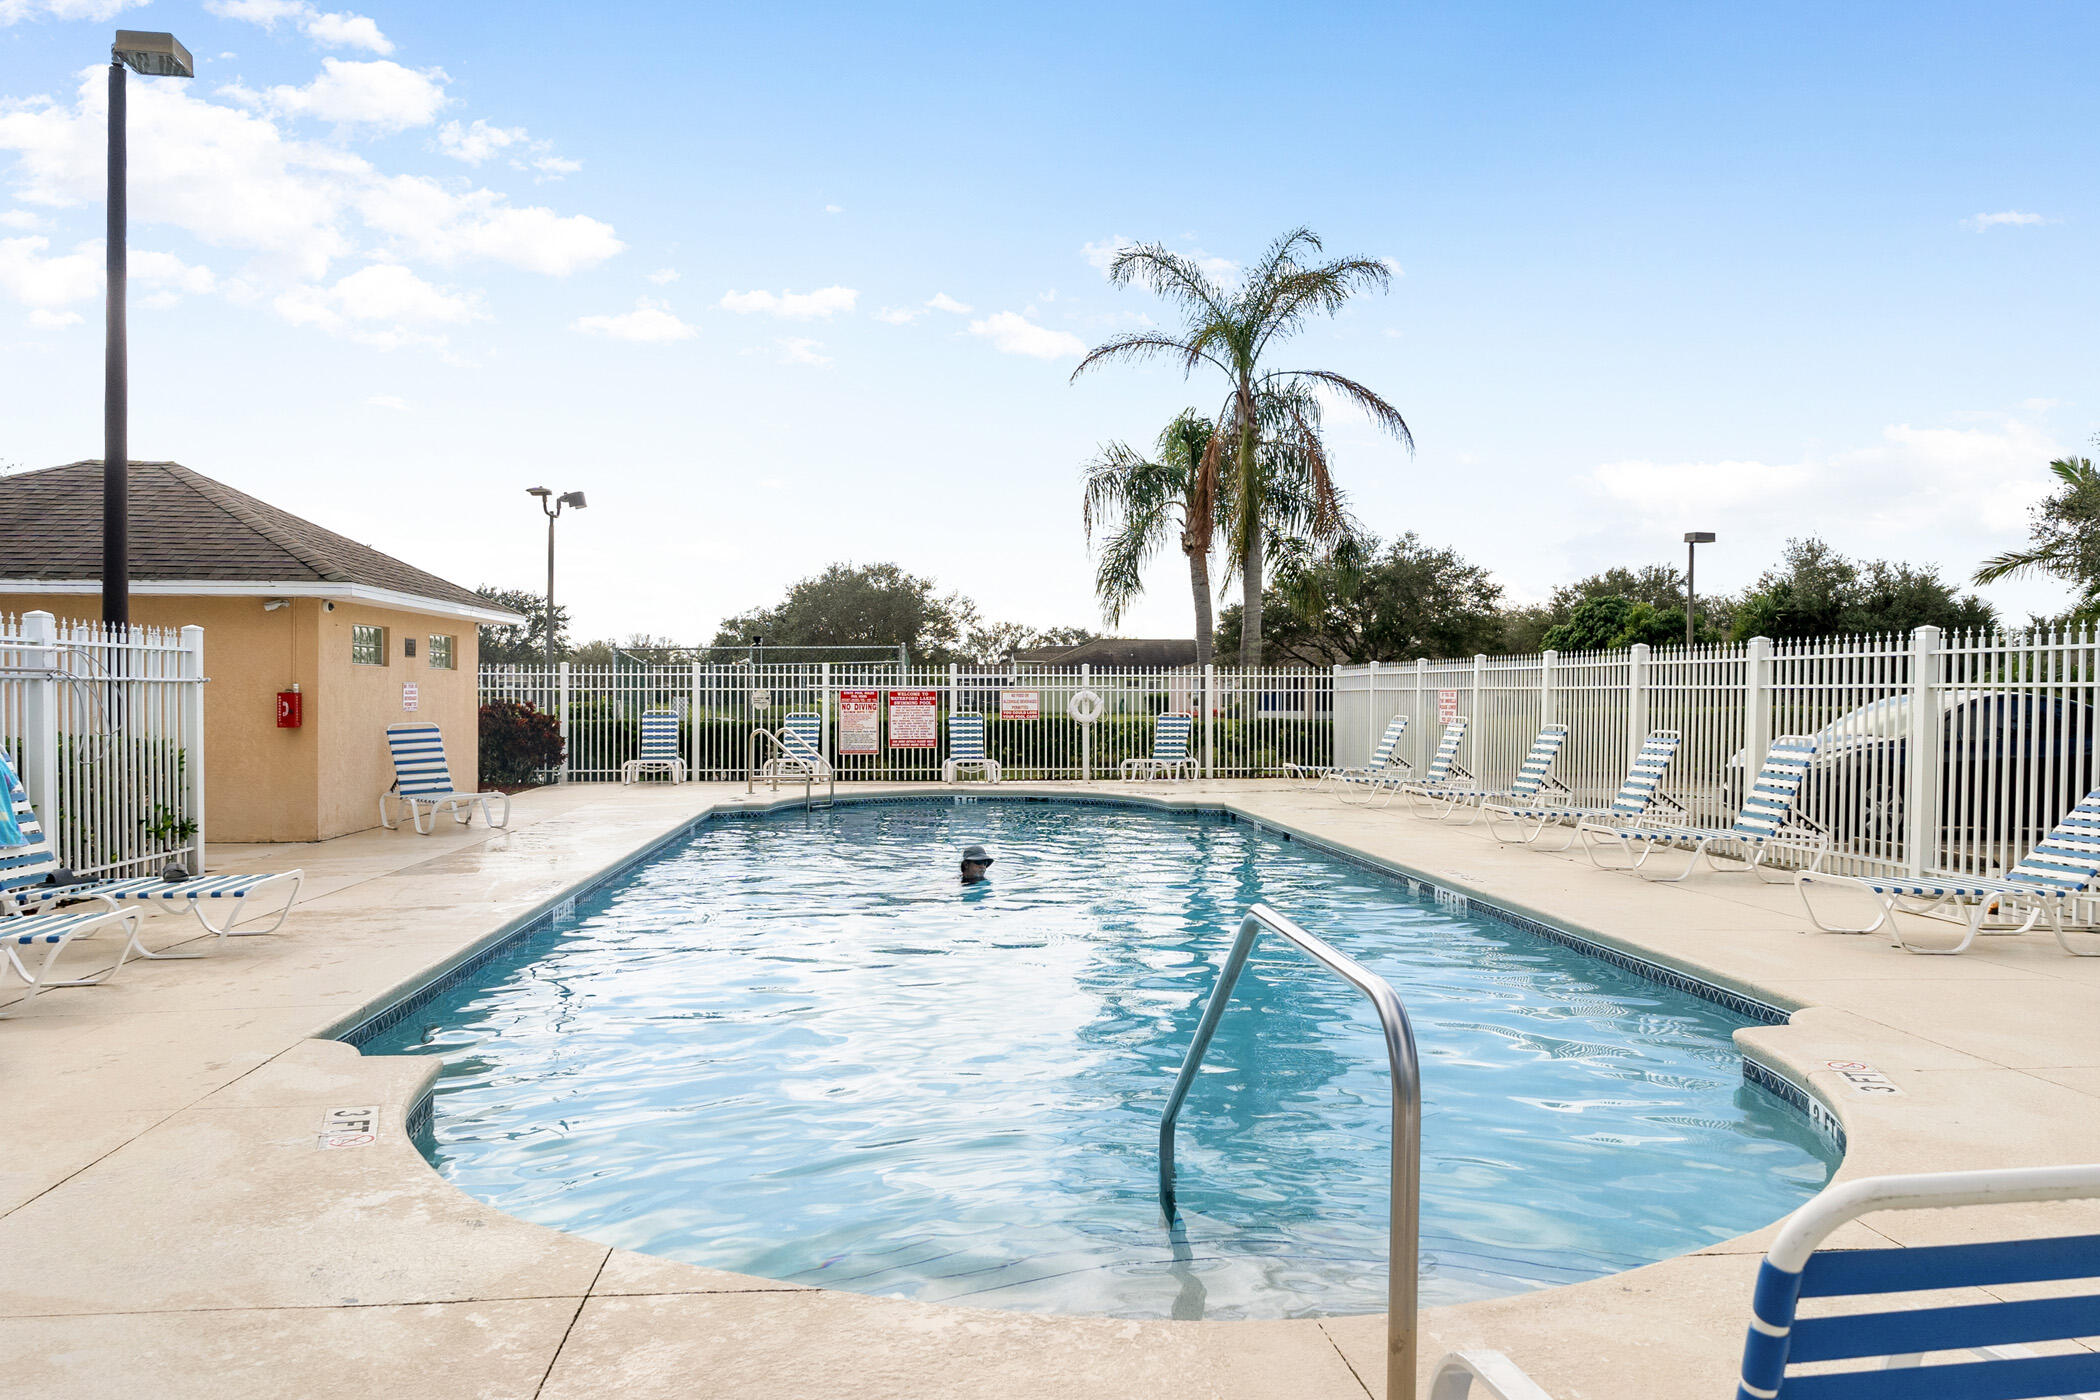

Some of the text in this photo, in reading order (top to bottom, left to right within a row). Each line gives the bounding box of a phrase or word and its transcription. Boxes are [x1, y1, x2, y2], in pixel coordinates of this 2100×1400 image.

[841, 703, 877, 711] NO DIVING
[966, 796, 976, 804] FT
[330, 1109, 371, 1133] 3 FT
[1824, 1112, 1836, 1140] FT
